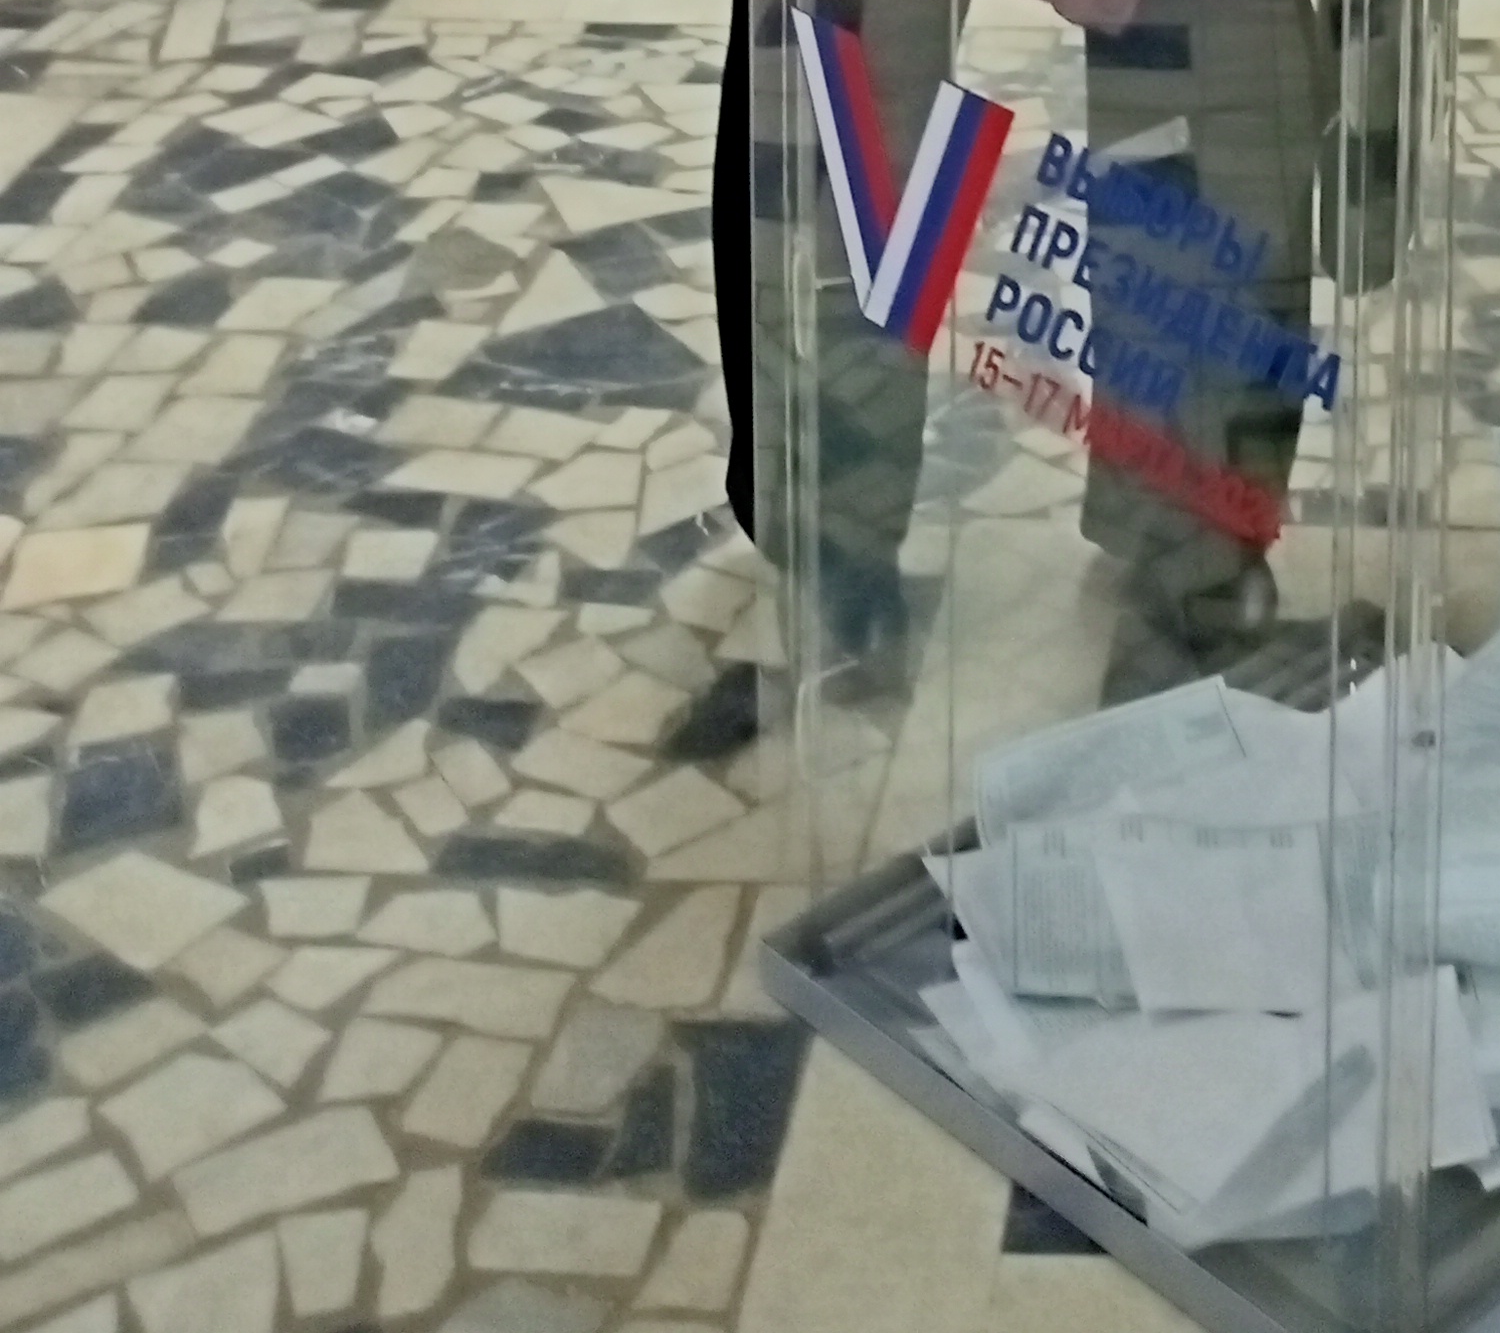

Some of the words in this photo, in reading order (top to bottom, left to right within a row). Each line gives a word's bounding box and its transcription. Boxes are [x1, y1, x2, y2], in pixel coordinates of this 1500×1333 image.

[1036, 132, 1270, 279] ВЫБОРЫ
[986, 274, 1187, 415] РОССИИ
[1010, 205, 1341, 411] ПРЕЗИДЕНТА
